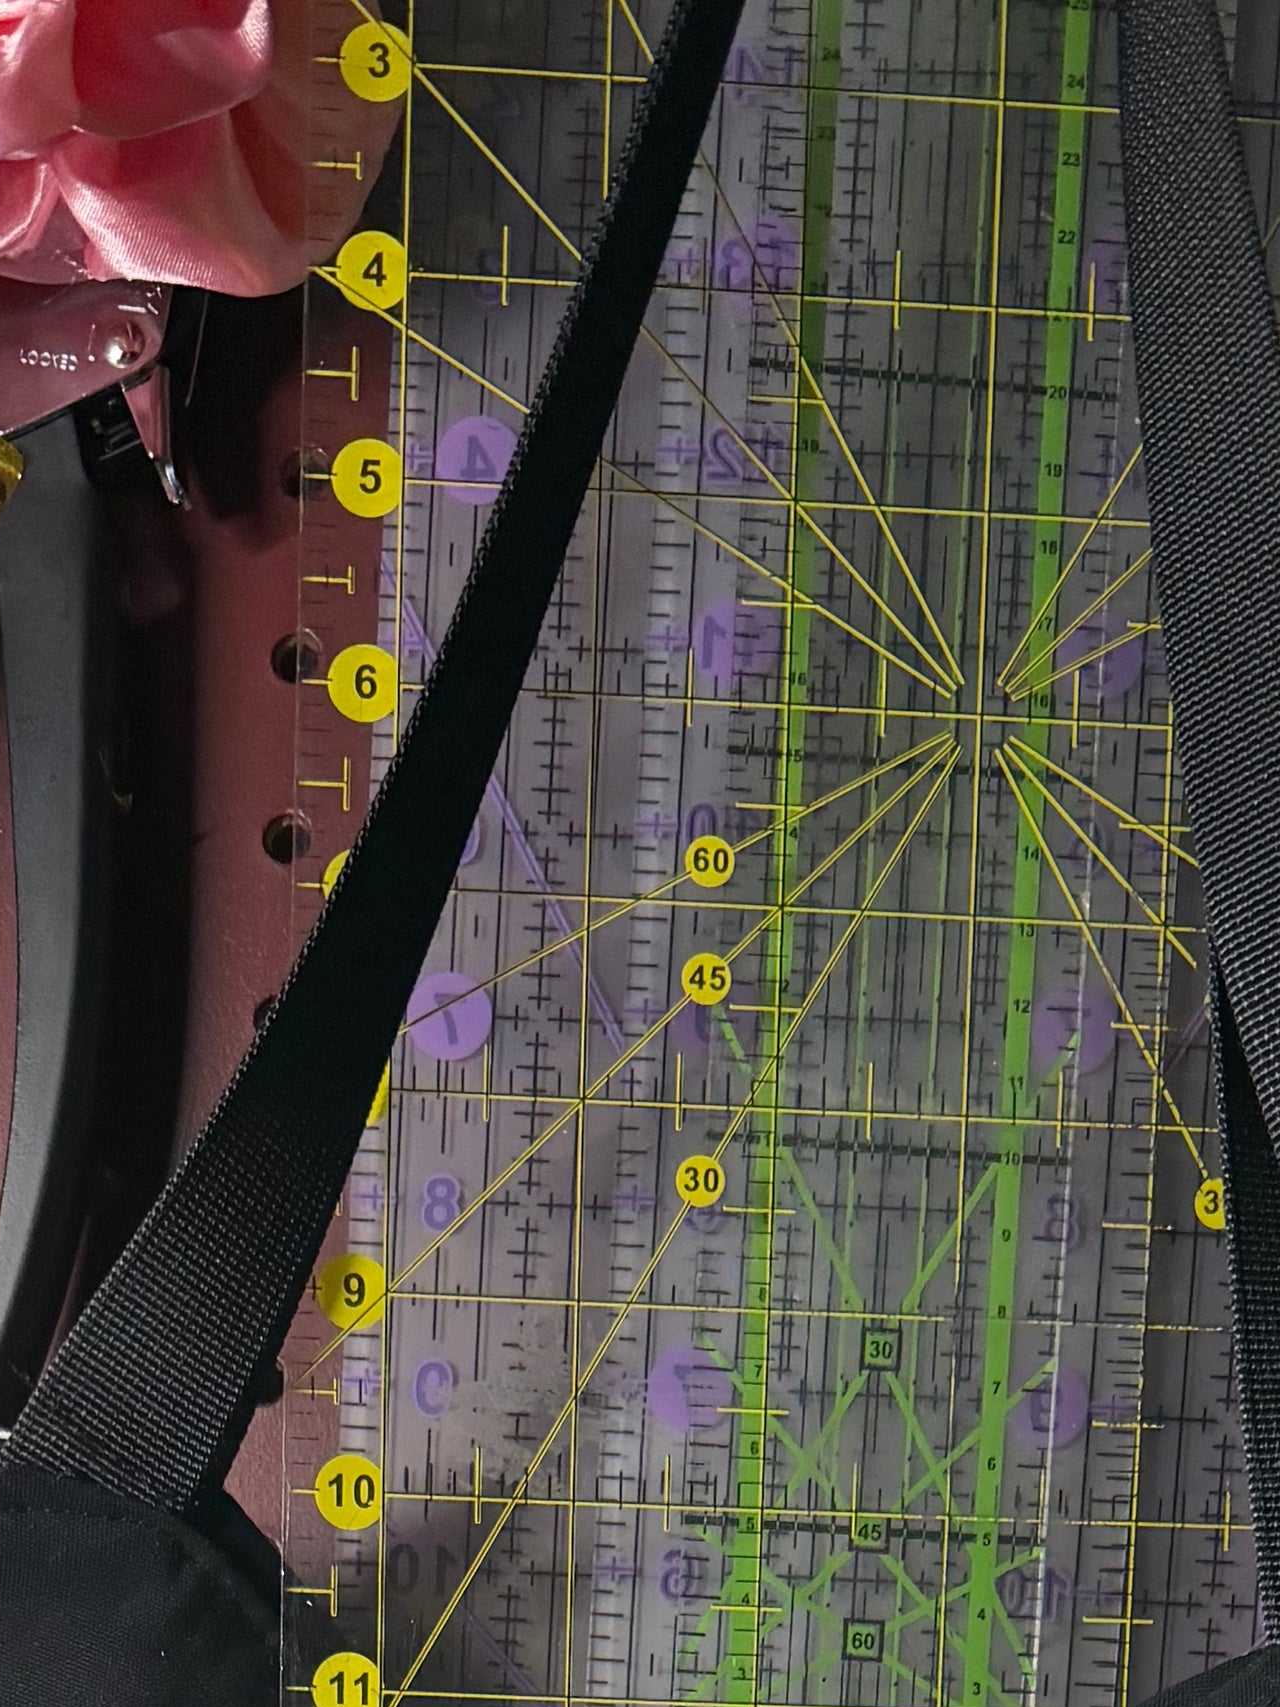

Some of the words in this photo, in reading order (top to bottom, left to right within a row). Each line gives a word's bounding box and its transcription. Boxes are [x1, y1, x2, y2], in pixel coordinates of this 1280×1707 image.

[367, 43, 391, 79] 3
[1066, 75, 1086, 90] 24
[1061, 153, 1081, 168] 23
[1057, 230, 1076, 245] 22
[363, 251, 387, 287] 4
[1048, 385, 1067, 400] 20
[359, 459, 382, 494] 5
[1043, 463, 1063, 478] 19
[355, 665, 377, 699] 6
[1022, 845, 1040, 860] 14
[693, 847, 729, 874] 60
[688, 964, 726, 991] 45
[1013, 998, 1031, 1014] 12
[683, 1166, 719, 1193] 30
[342, 1273, 366, 1310] 9
[869, 1340, 894, 1360] 30
[754, 1364, 762, 1378] 7
[992, 1381, 1001, 1396] 7
[750, 1441, 759, 1455] 6
[987, 1456, 996, 1471] 6
[328, 1474, 375, 1509] 10
[746, 1517, 755, 1531] 5
[857, 1523, 883, 1542] 45
[982, 1532, 991, 1547] 5
[741, 1594, 751, 1606] 4
[976, 1607, 986, 1621] 4
[851, 1631, 876, 1651] 60
[329, 1672, 369, 1706] 11
[972, 1682, 981, 1696] 3
